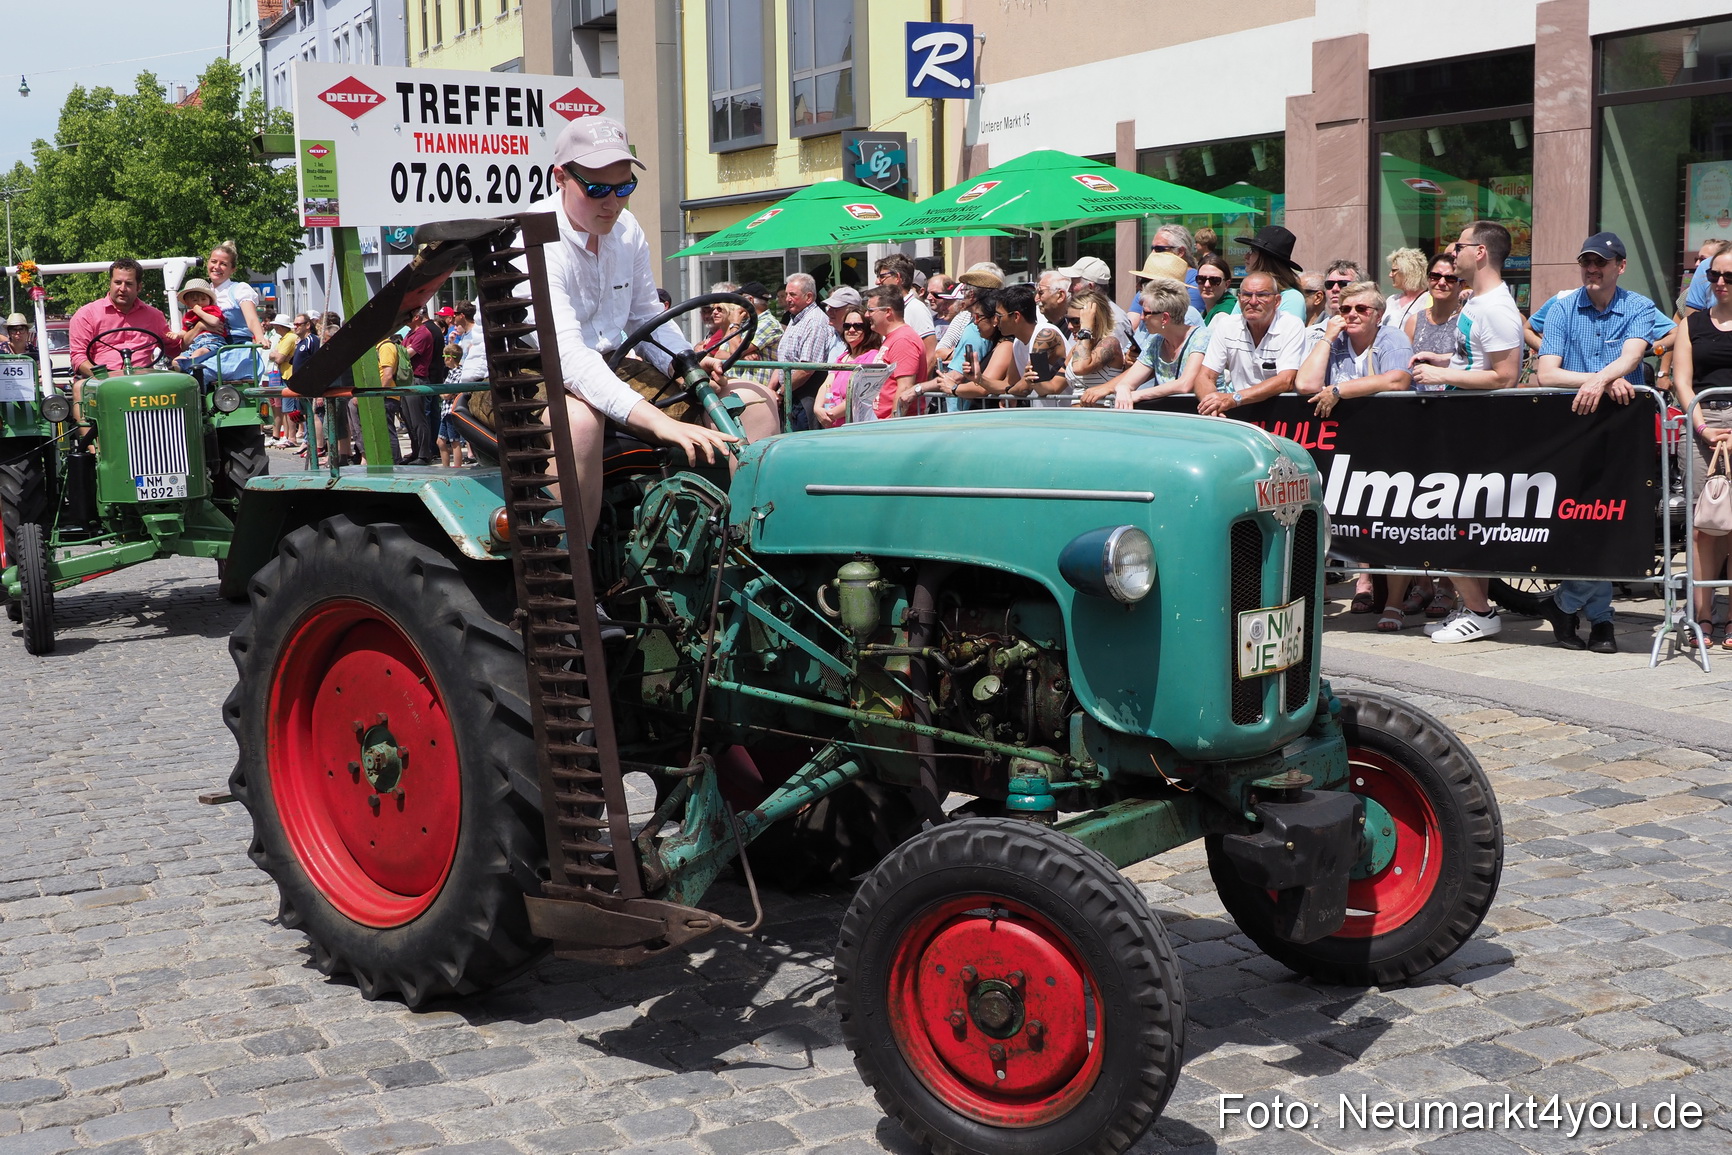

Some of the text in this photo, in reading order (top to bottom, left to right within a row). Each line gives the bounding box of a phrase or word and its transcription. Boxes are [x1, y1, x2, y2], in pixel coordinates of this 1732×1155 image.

[326, 92, 379, 104] DEUTZ
[396, 82, 544, 128] TREFFEN
[555, 101, 600, 113] DEUTZ
[980, 112, 1031, 134] Unterer Markt 15
[414, 132, 529, 155] THANNHAUSEN
[869, 150, 892, 179] G2
[1495, 182, 1530, 196] Grillen
[1081, 194, 1156, 204] Neumarkter
[923, 204, 983, 216] Neumarkter
[1077, 201, 1183, 213] Lammsbräu
[899, 212, 981, 227] Lammsbräu
[394, 227, 408, 243] G2
[3, 367, 24, 377] 455
[129, 393, 177, 408] FENDT
[146, 476, 163, 487] NM
[1318, 453, 1626, 520] lmann GmbH
[1257, 478, 1309, 507] Kramer
[1371, 521, 1456, 544] Freystadt
[1467, 522, 1550, 545] Pyrbaum
[1267, 608, 1294, 640] NM
[1250, 642, 1277, 672] JE
